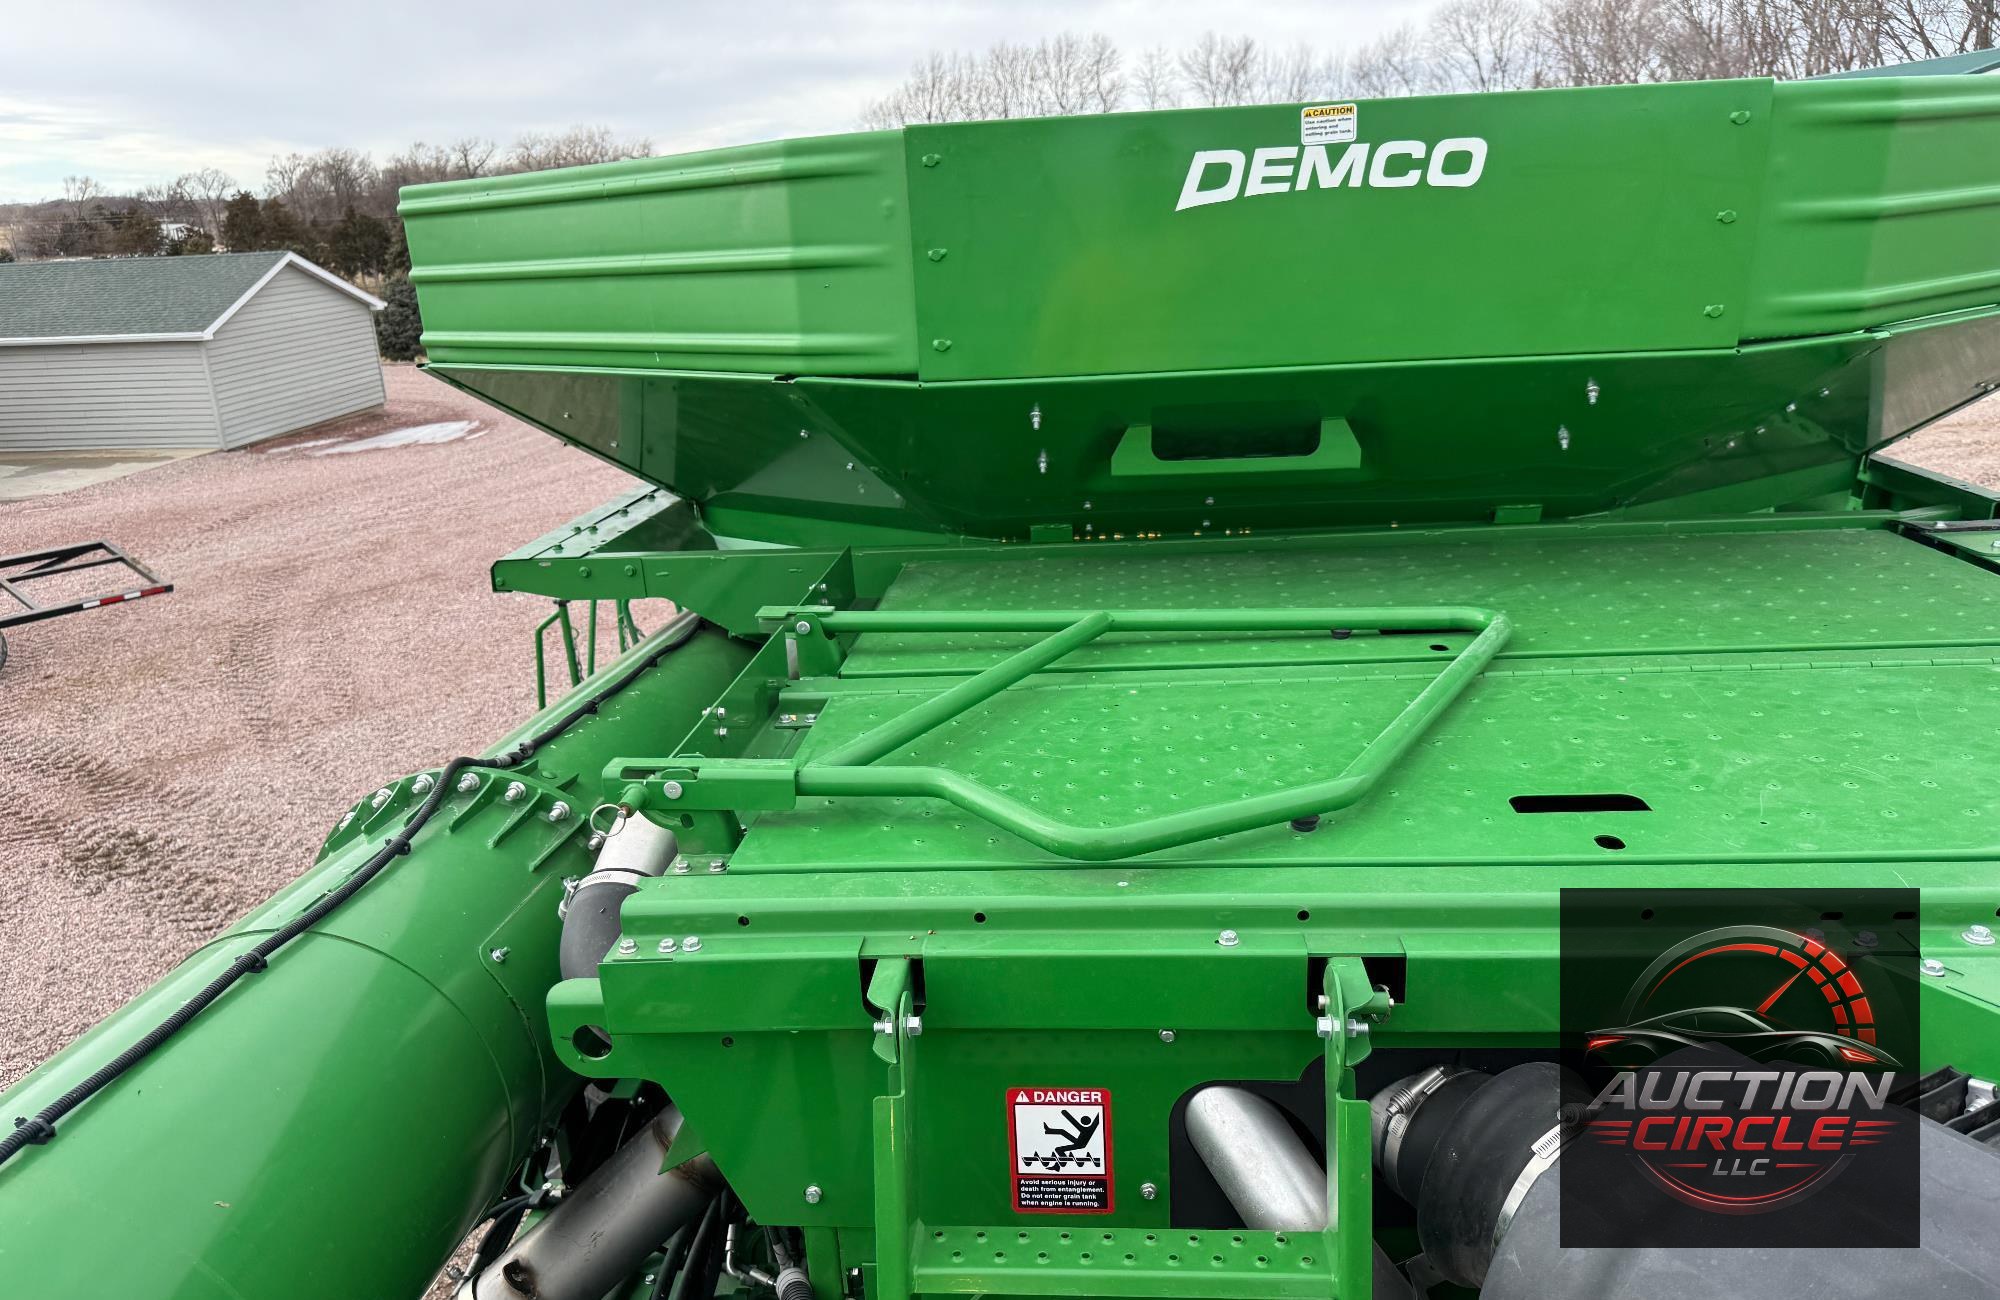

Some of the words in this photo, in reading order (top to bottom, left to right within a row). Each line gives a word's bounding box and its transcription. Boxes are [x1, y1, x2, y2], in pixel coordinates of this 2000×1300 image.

[1313, 107, 1352, 116] CAUTION
[1175, 137, 1487, 211] DEMCO
[1034, 1092, 1101, 1102] DANGER
